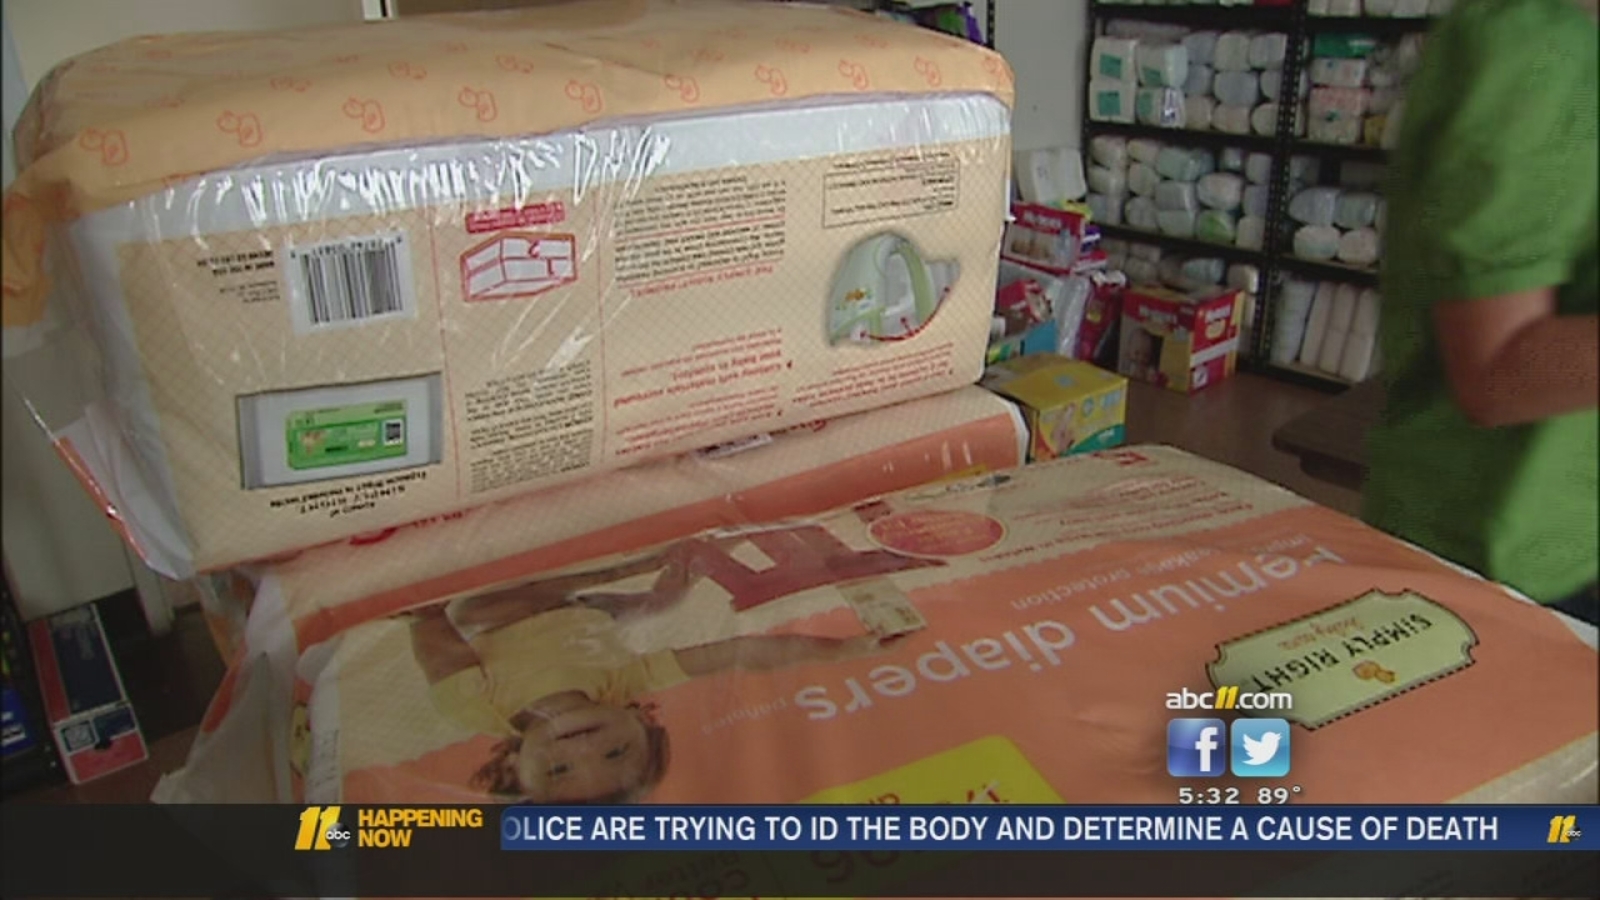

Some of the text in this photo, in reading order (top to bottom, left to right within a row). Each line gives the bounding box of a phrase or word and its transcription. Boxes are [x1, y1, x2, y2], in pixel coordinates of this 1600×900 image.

[794, 619, 1076, 723] diapers
[1249, 612, 1434, 694] SIMPLY RIGHT
